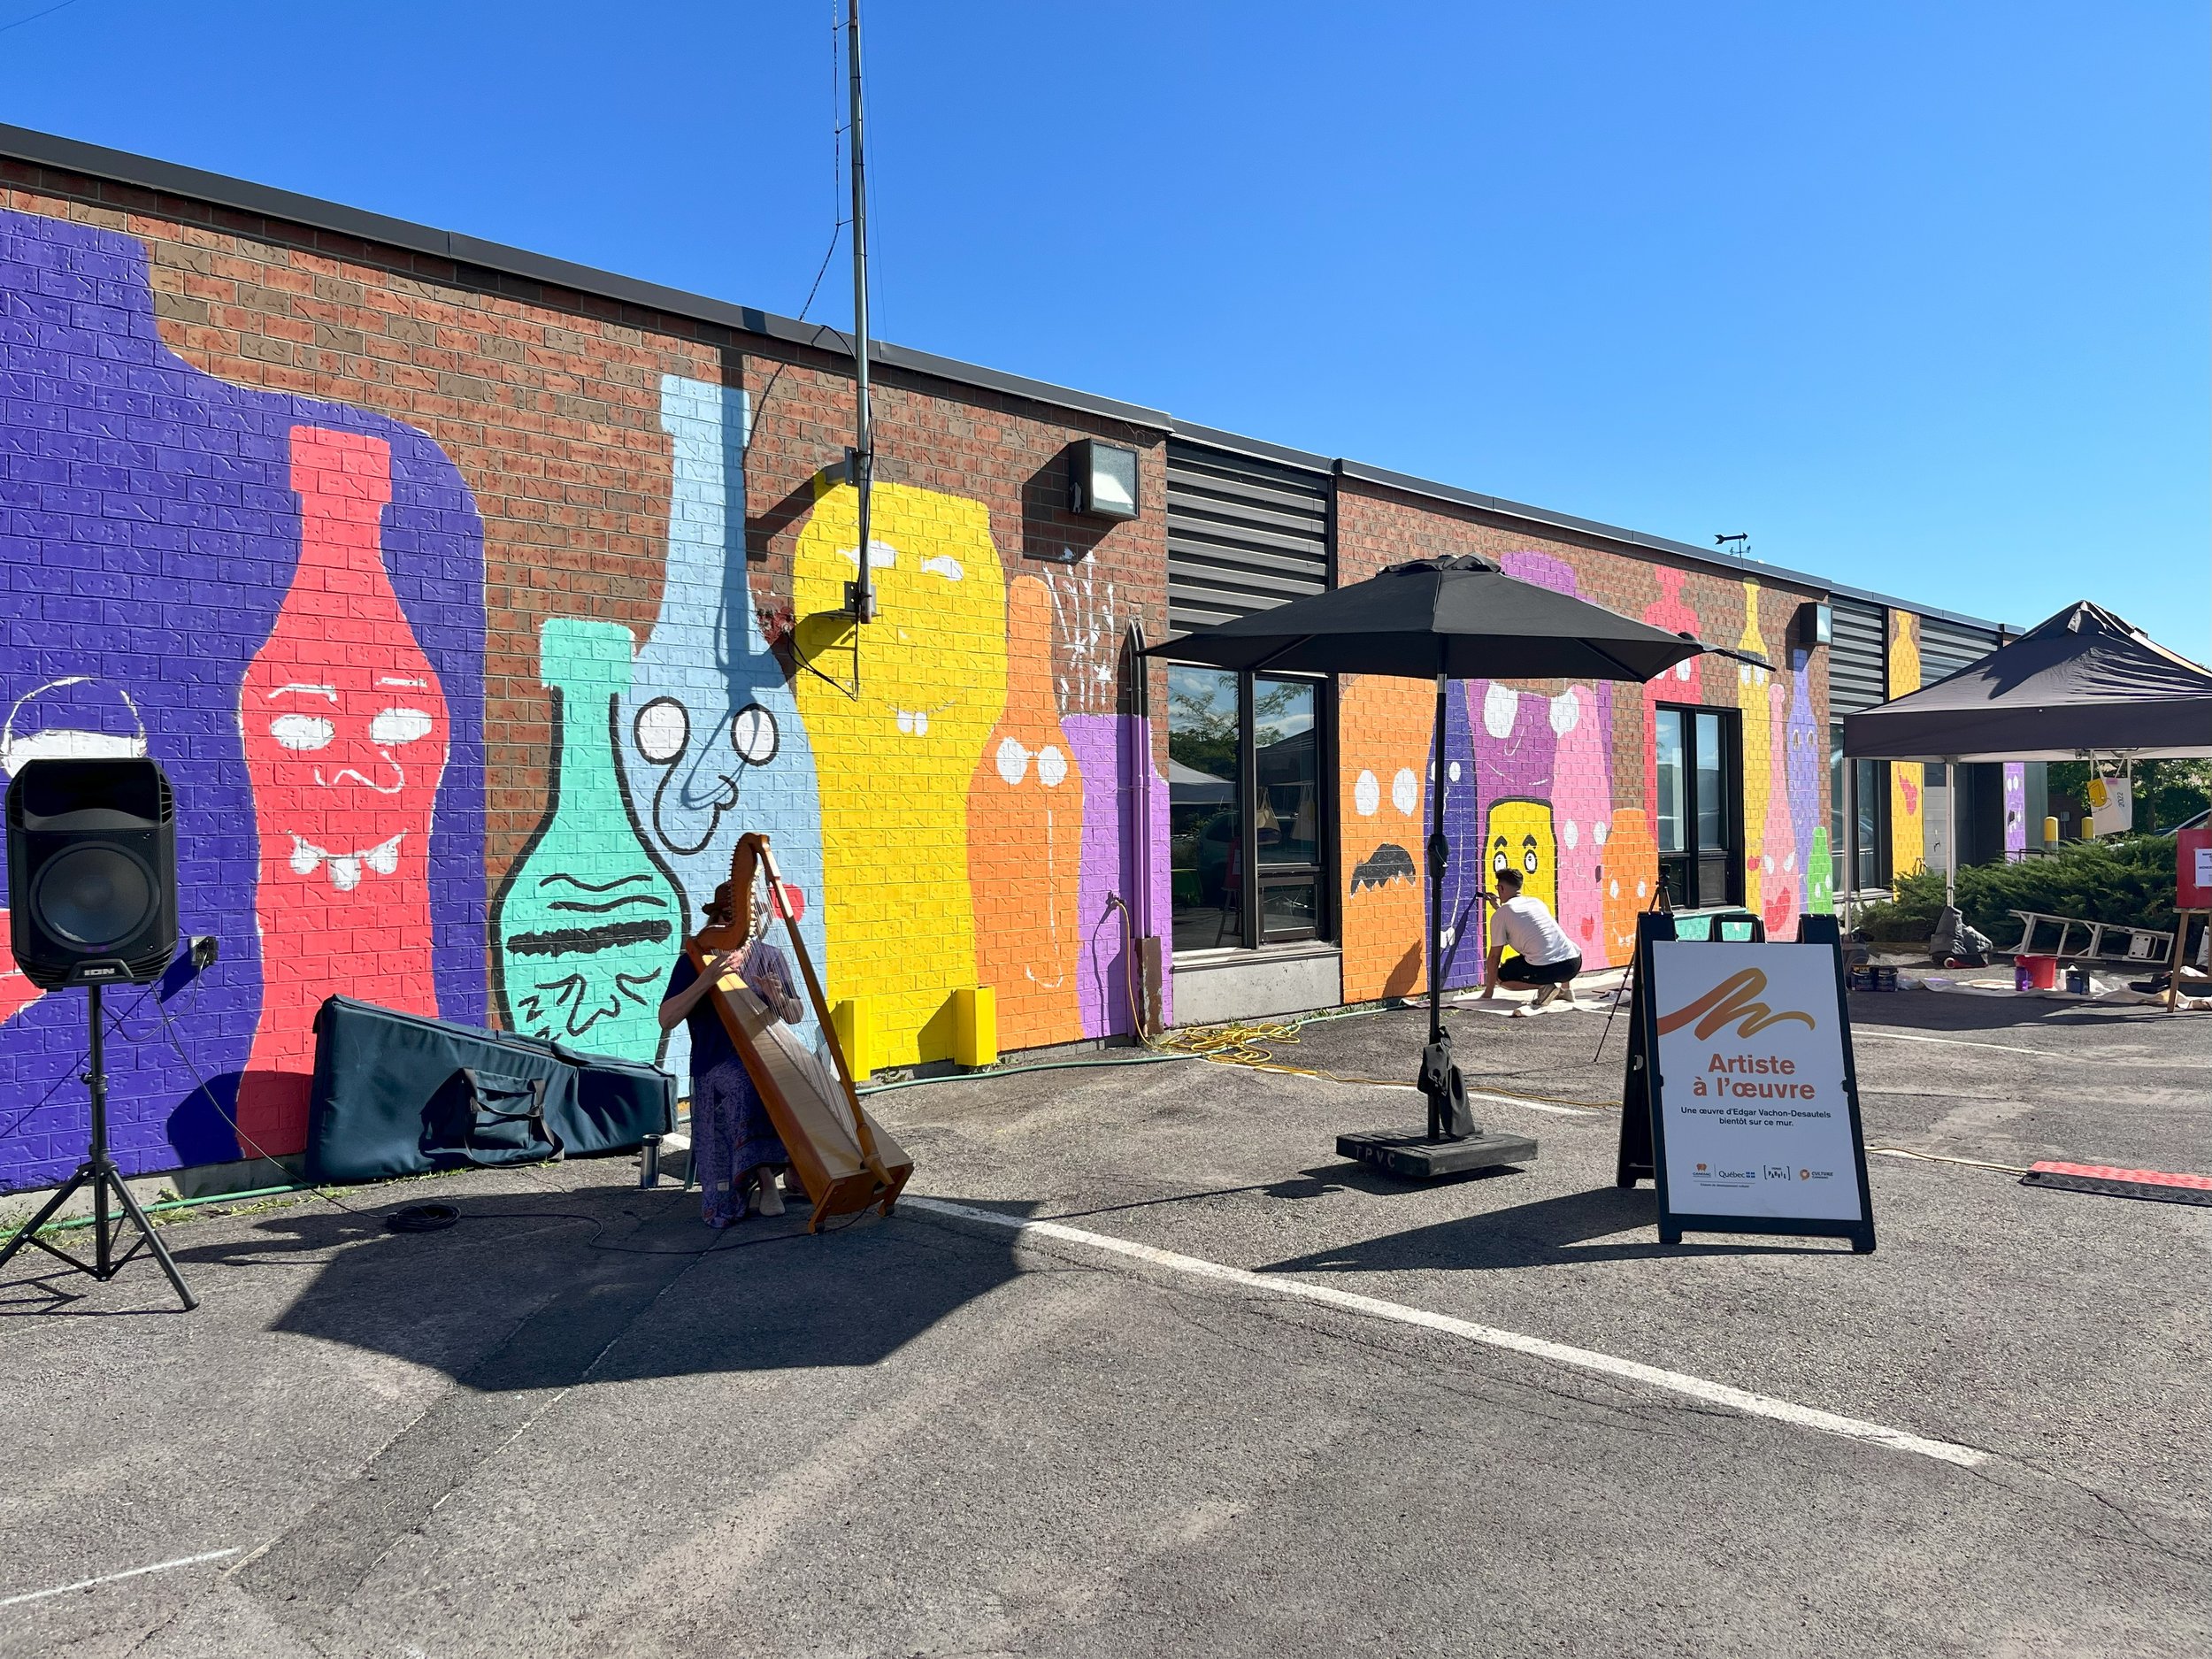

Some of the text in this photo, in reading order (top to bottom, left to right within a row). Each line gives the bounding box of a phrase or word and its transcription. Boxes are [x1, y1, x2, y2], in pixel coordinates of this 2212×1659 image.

[2116, 792, 2125, 807] 2022
[1708, 1053, 1795, 1075] Artiste
[1693, 1076, 1708, 1096] à
[1680, 1106, 1697, 1115] Une
[1726, 1108, 1756, 1118] d'Edgar
[1758, 1109, 1832, 1118] Vachon-Desautels
[1719, 1117, 1747, 1125] bientôt
